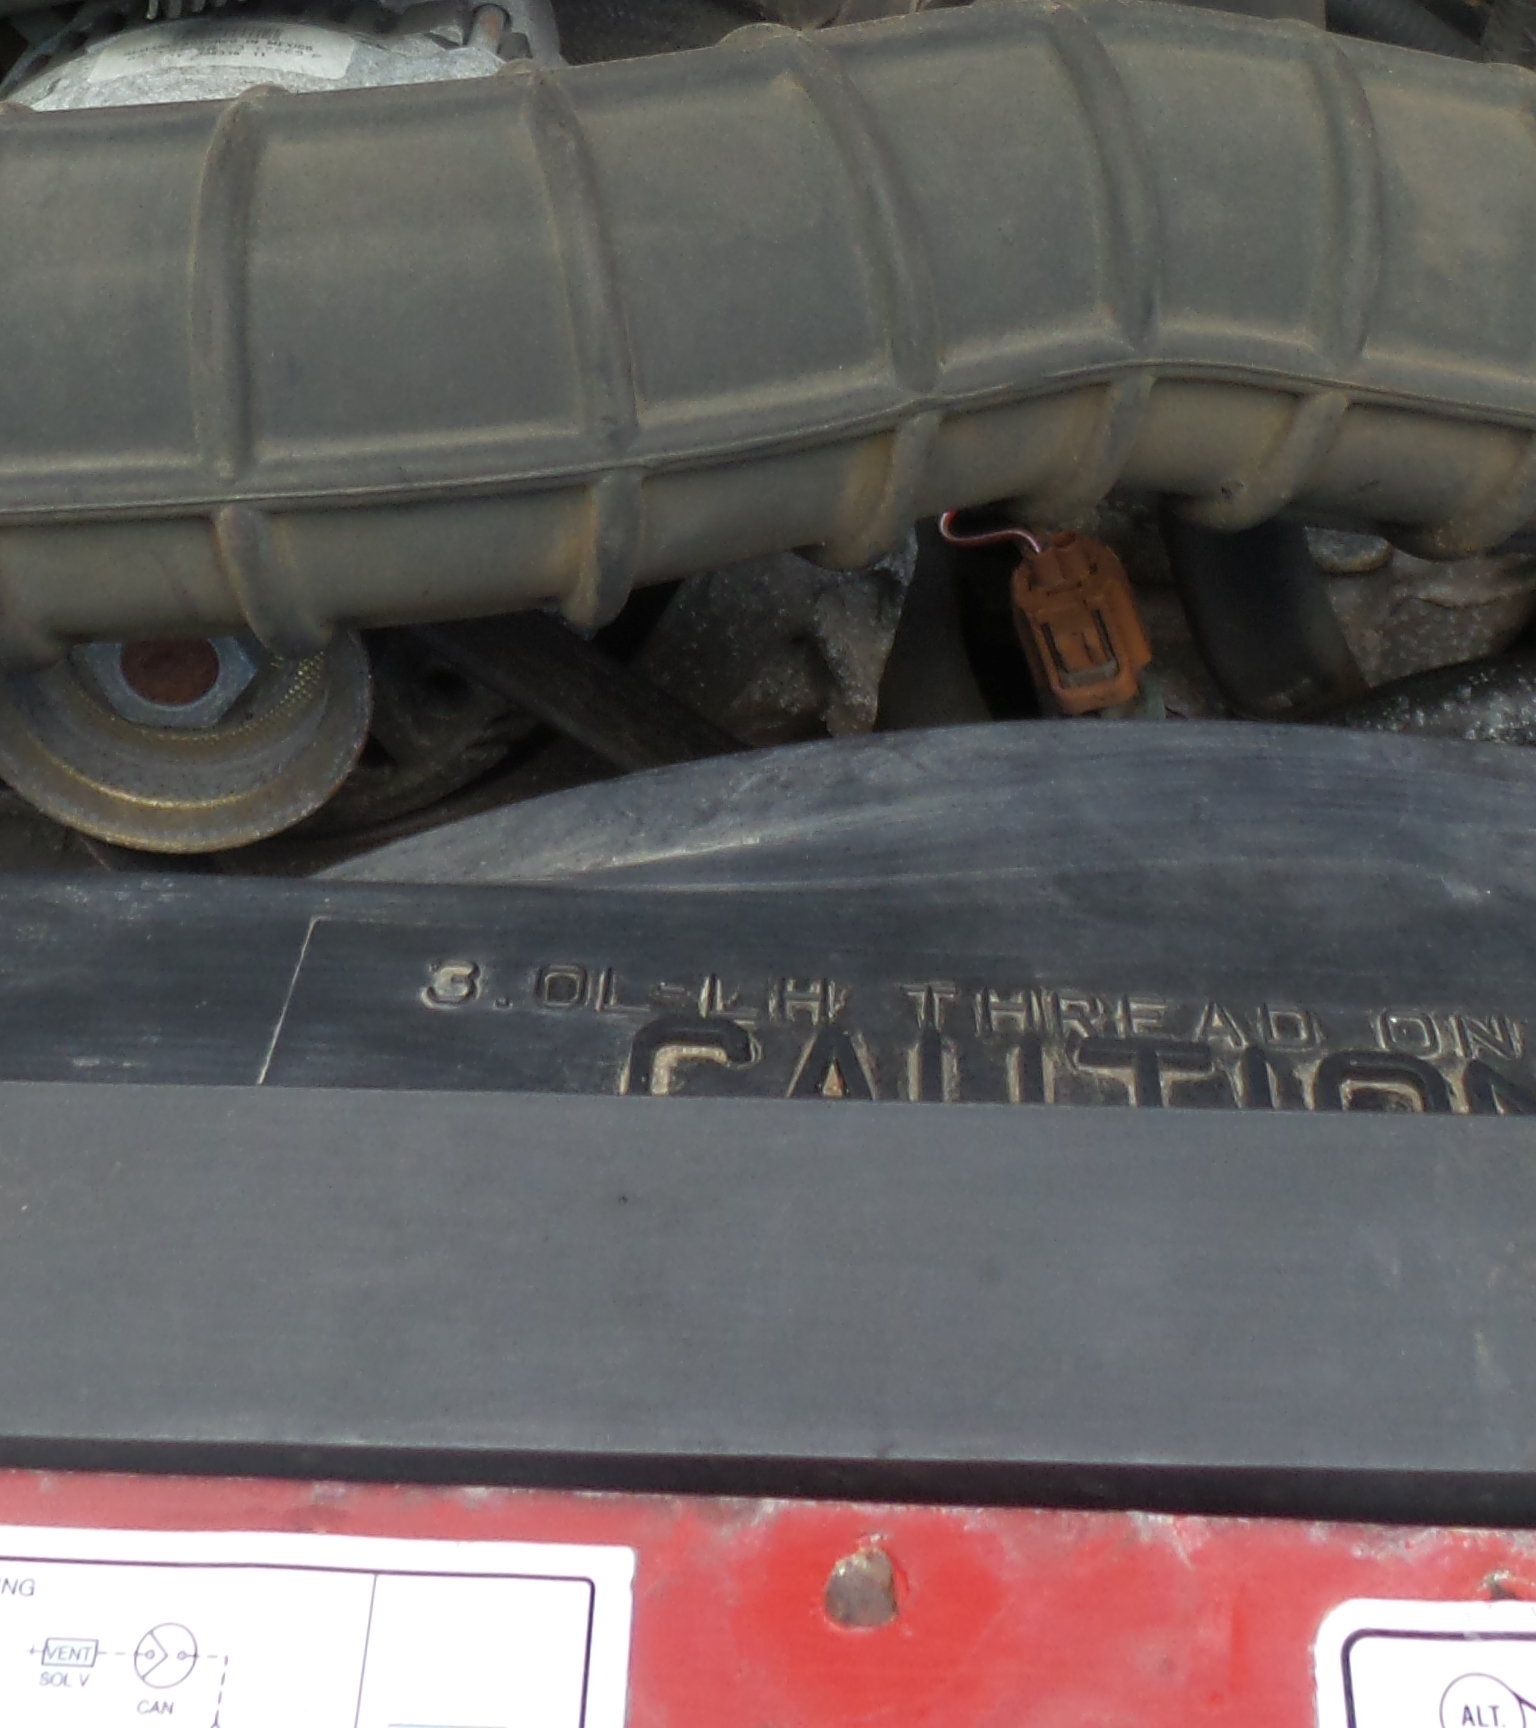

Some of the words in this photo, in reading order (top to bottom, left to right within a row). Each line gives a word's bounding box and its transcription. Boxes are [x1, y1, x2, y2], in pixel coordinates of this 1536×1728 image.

[902, 981, 1326, 1050] THREAD
[1370, 1006, 1526, 1062] ON
[44, 1644, 93, 1663] VENT
[38, 1672, 75, 1689] SOL
[78, 1673, 91, 1689] V
[136, 1699, 175, 1717] CAN
